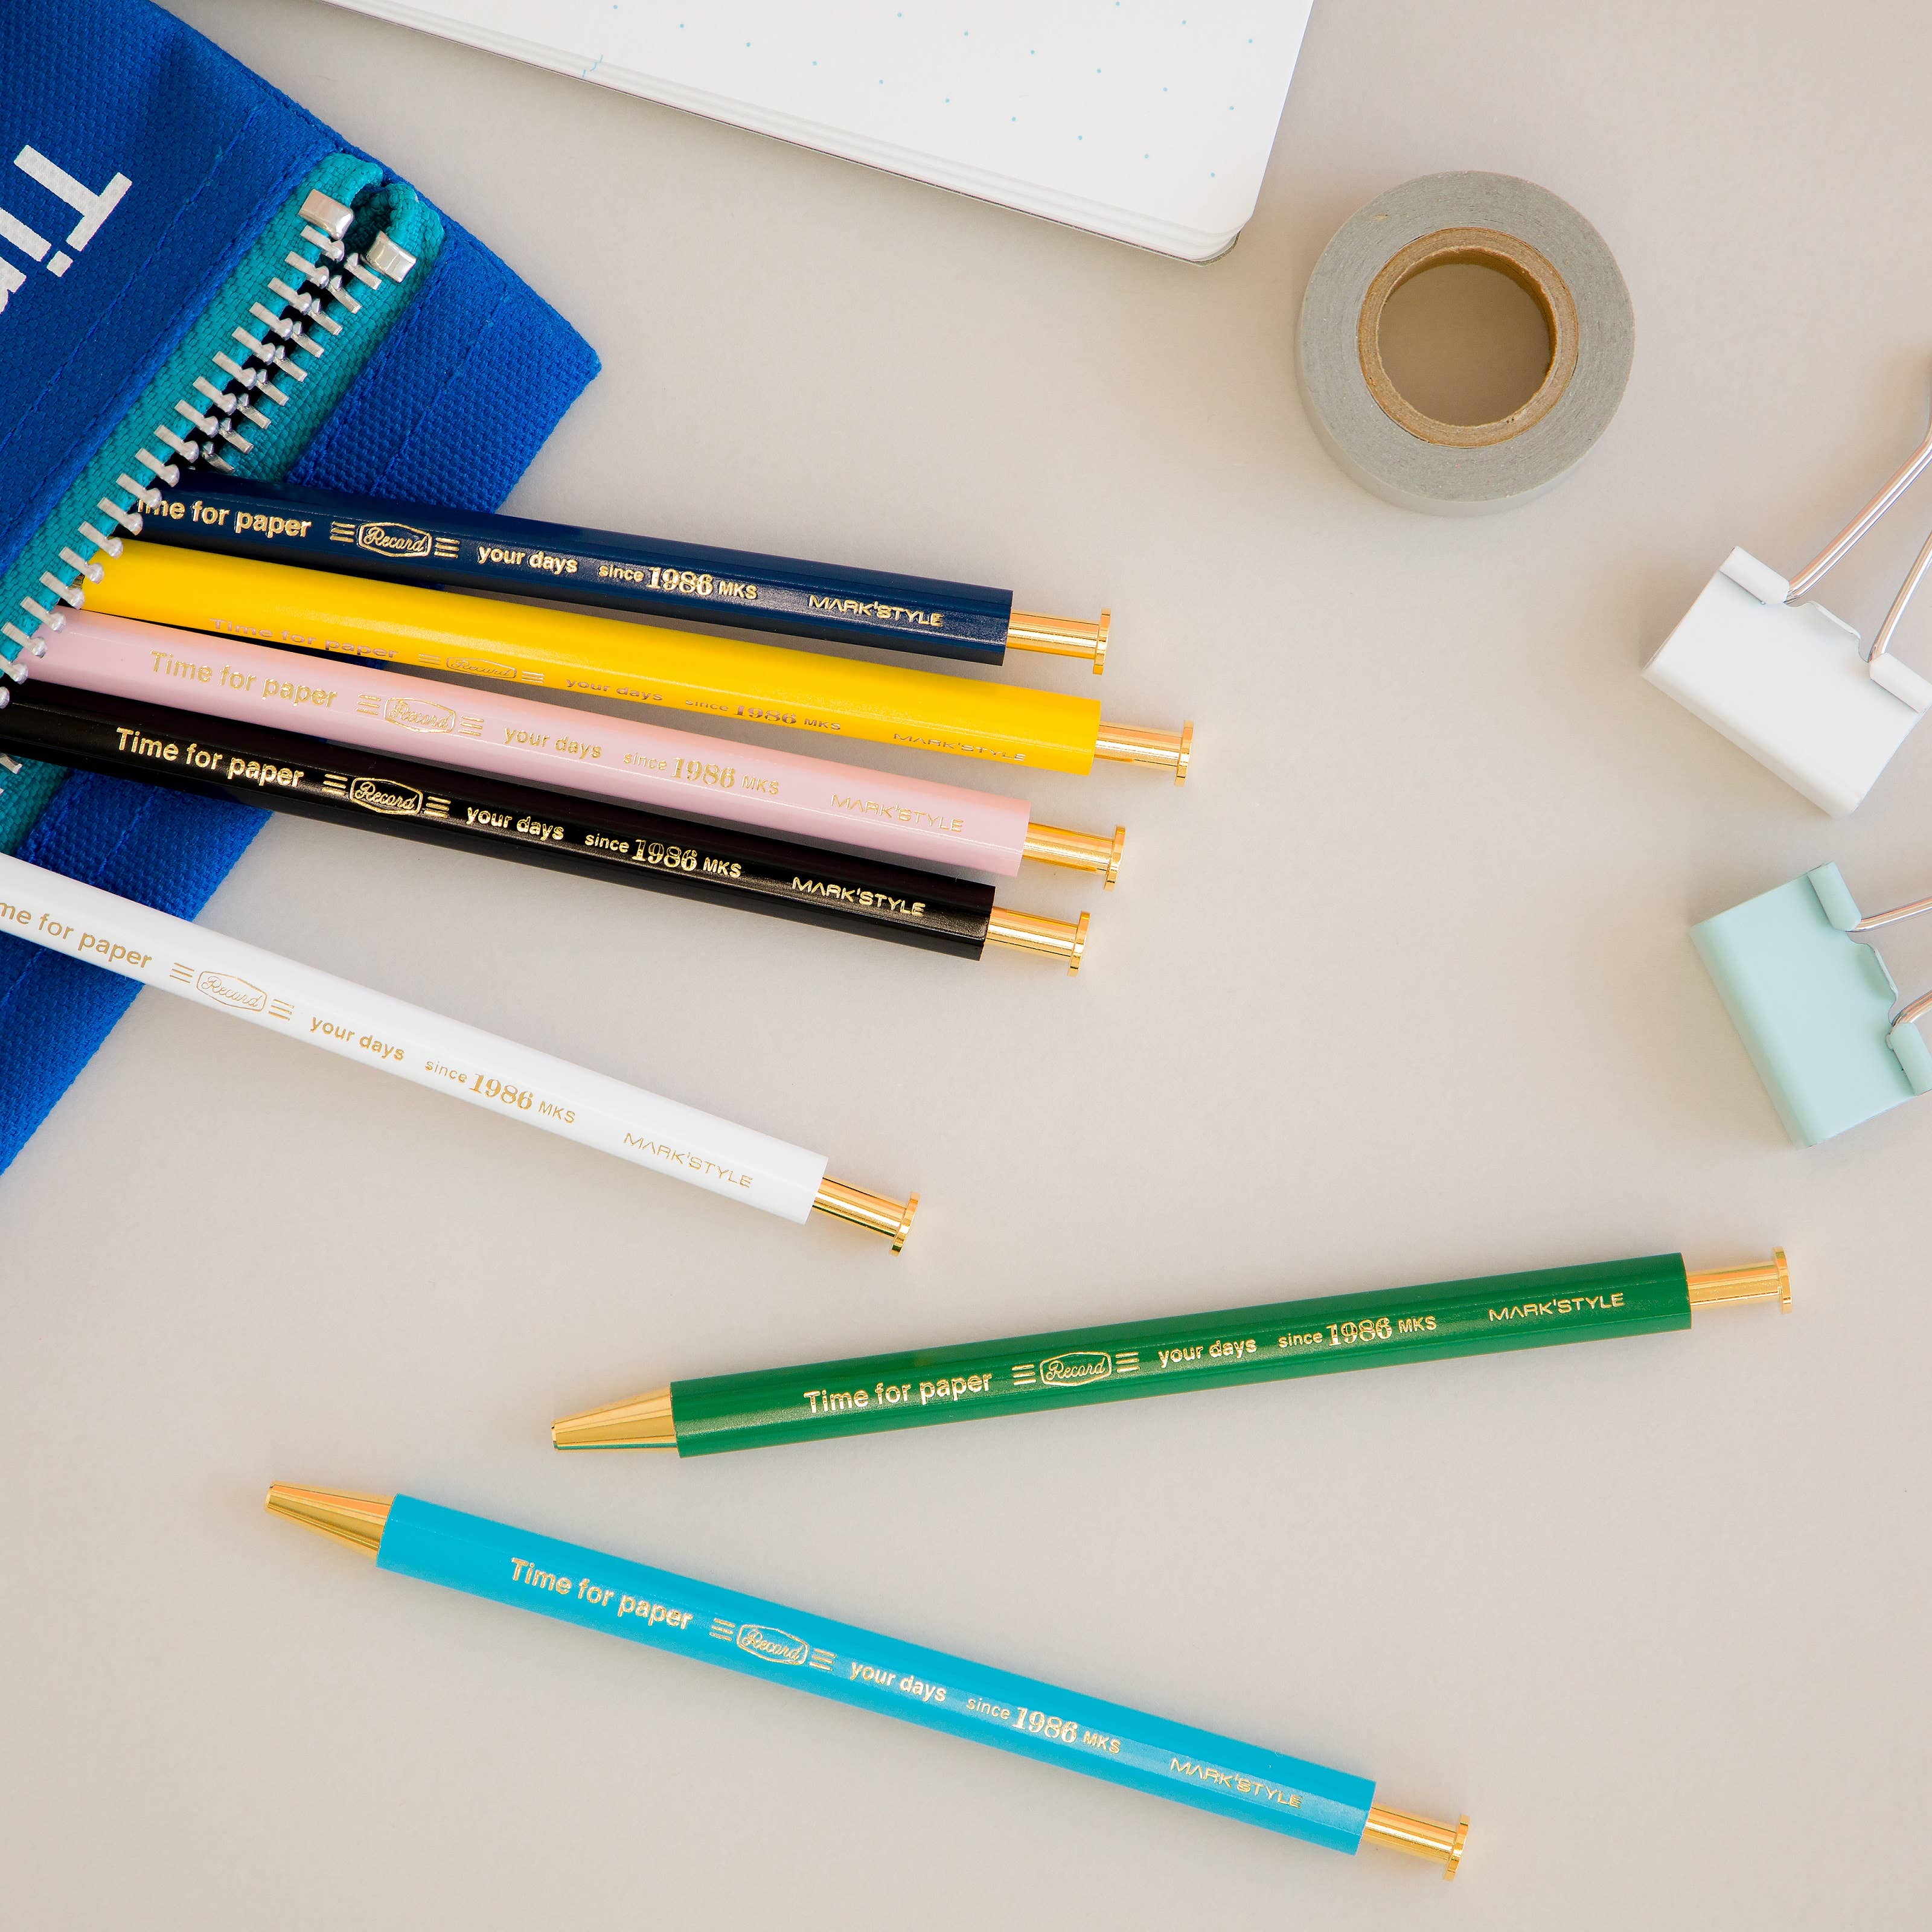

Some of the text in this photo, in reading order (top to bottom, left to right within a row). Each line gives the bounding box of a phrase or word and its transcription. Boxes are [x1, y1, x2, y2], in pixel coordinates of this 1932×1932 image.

[0, 144, 132, 314] Ti
[138, 499, 185, 519] ime
[193, 501, 230, 526] for
[235, 512, 312, 539] paper
[363, 526, 426, 552] Record
[477, 546, 525, 566] your
[529, 551, 578, 574] days
[598, 564, 644, 582] since
[646, 566, 713, 596] 1986
[718, 580, 758, 600] MKS
[150, 649, 213, 683] Time
[220, 665, 256, 692] for
[262, 678, 337, 708] paper
[388, 701, 452, 731] Record
[504, 727, 550, 749] your
[554, 735, 602, 760] days
[622, 750, 668, 771] since
[670, 757, 736, 788] 1986
[741, 775, 779, 795] MKS
[210, 618, 272, 639] Time
[281, 630, 316, 645] for
[325, 638, 398, 659] paper
[451, 657, 514, 679] Record
[566, 678, 611, 693] your
[616, 686, 663, 702] days
[685, 699, 729, 712] since
[734, 704, 797, 725] 1986
[804, 718, 842, 731] MKS
[116, 727, 179, 762] Time
[186, 743, 223, 771] for
[228, 755, 305, 788] paper
[354, 781, 417, 811] Record
[465, 805, 513, 830] your
[516, 816, 565, 842] days
[584, 832, 630, 853] since
[631, 839, 697, 871] 1986
[703, 857, 742, 878] MKS
[0, 903, 31, 925] me
[39, 913, 74, 939] for
[77, 932, 152, 969] paper
[200, 976, 263, 1008] Record
[311, 1016, 355, 1042] your
[358, 1034, 405, 1062] days
[424, 1059, 467, 1083] since
[468, 1073, 534, 1110] 1986
[538, 1101, 576, 1124] MKS
[803, 1390, 869, 1414] Time
[875, 1381, 910, 1406] for
[919, 1372, 993, 1407] paper
[1046, 1355, 1108, 1382] Record
[1157, 1343, 1204, 1369] your
[1209, 1337, 1257, 1363] days
[1278, 1330, 1323, 1348] since
[1326, 1317, 1392, 1346] 1986
[1398, 1315, 1437, 1334] MKS
[511, 1557, 572, 1595] Time
[578, 1577, 614, 1608] for
[618, 1593, 693, 1630] paper
[741, 1629, 804, 1661] Record
[849, 1662, 897, 1688] your
[900, 1674, 947, 1703] days
[965, 1697, 1011, 1721] since
[1012, 1707, 1078, 1744] 1986
[1083, 1730, 1121, 1754] MKS
